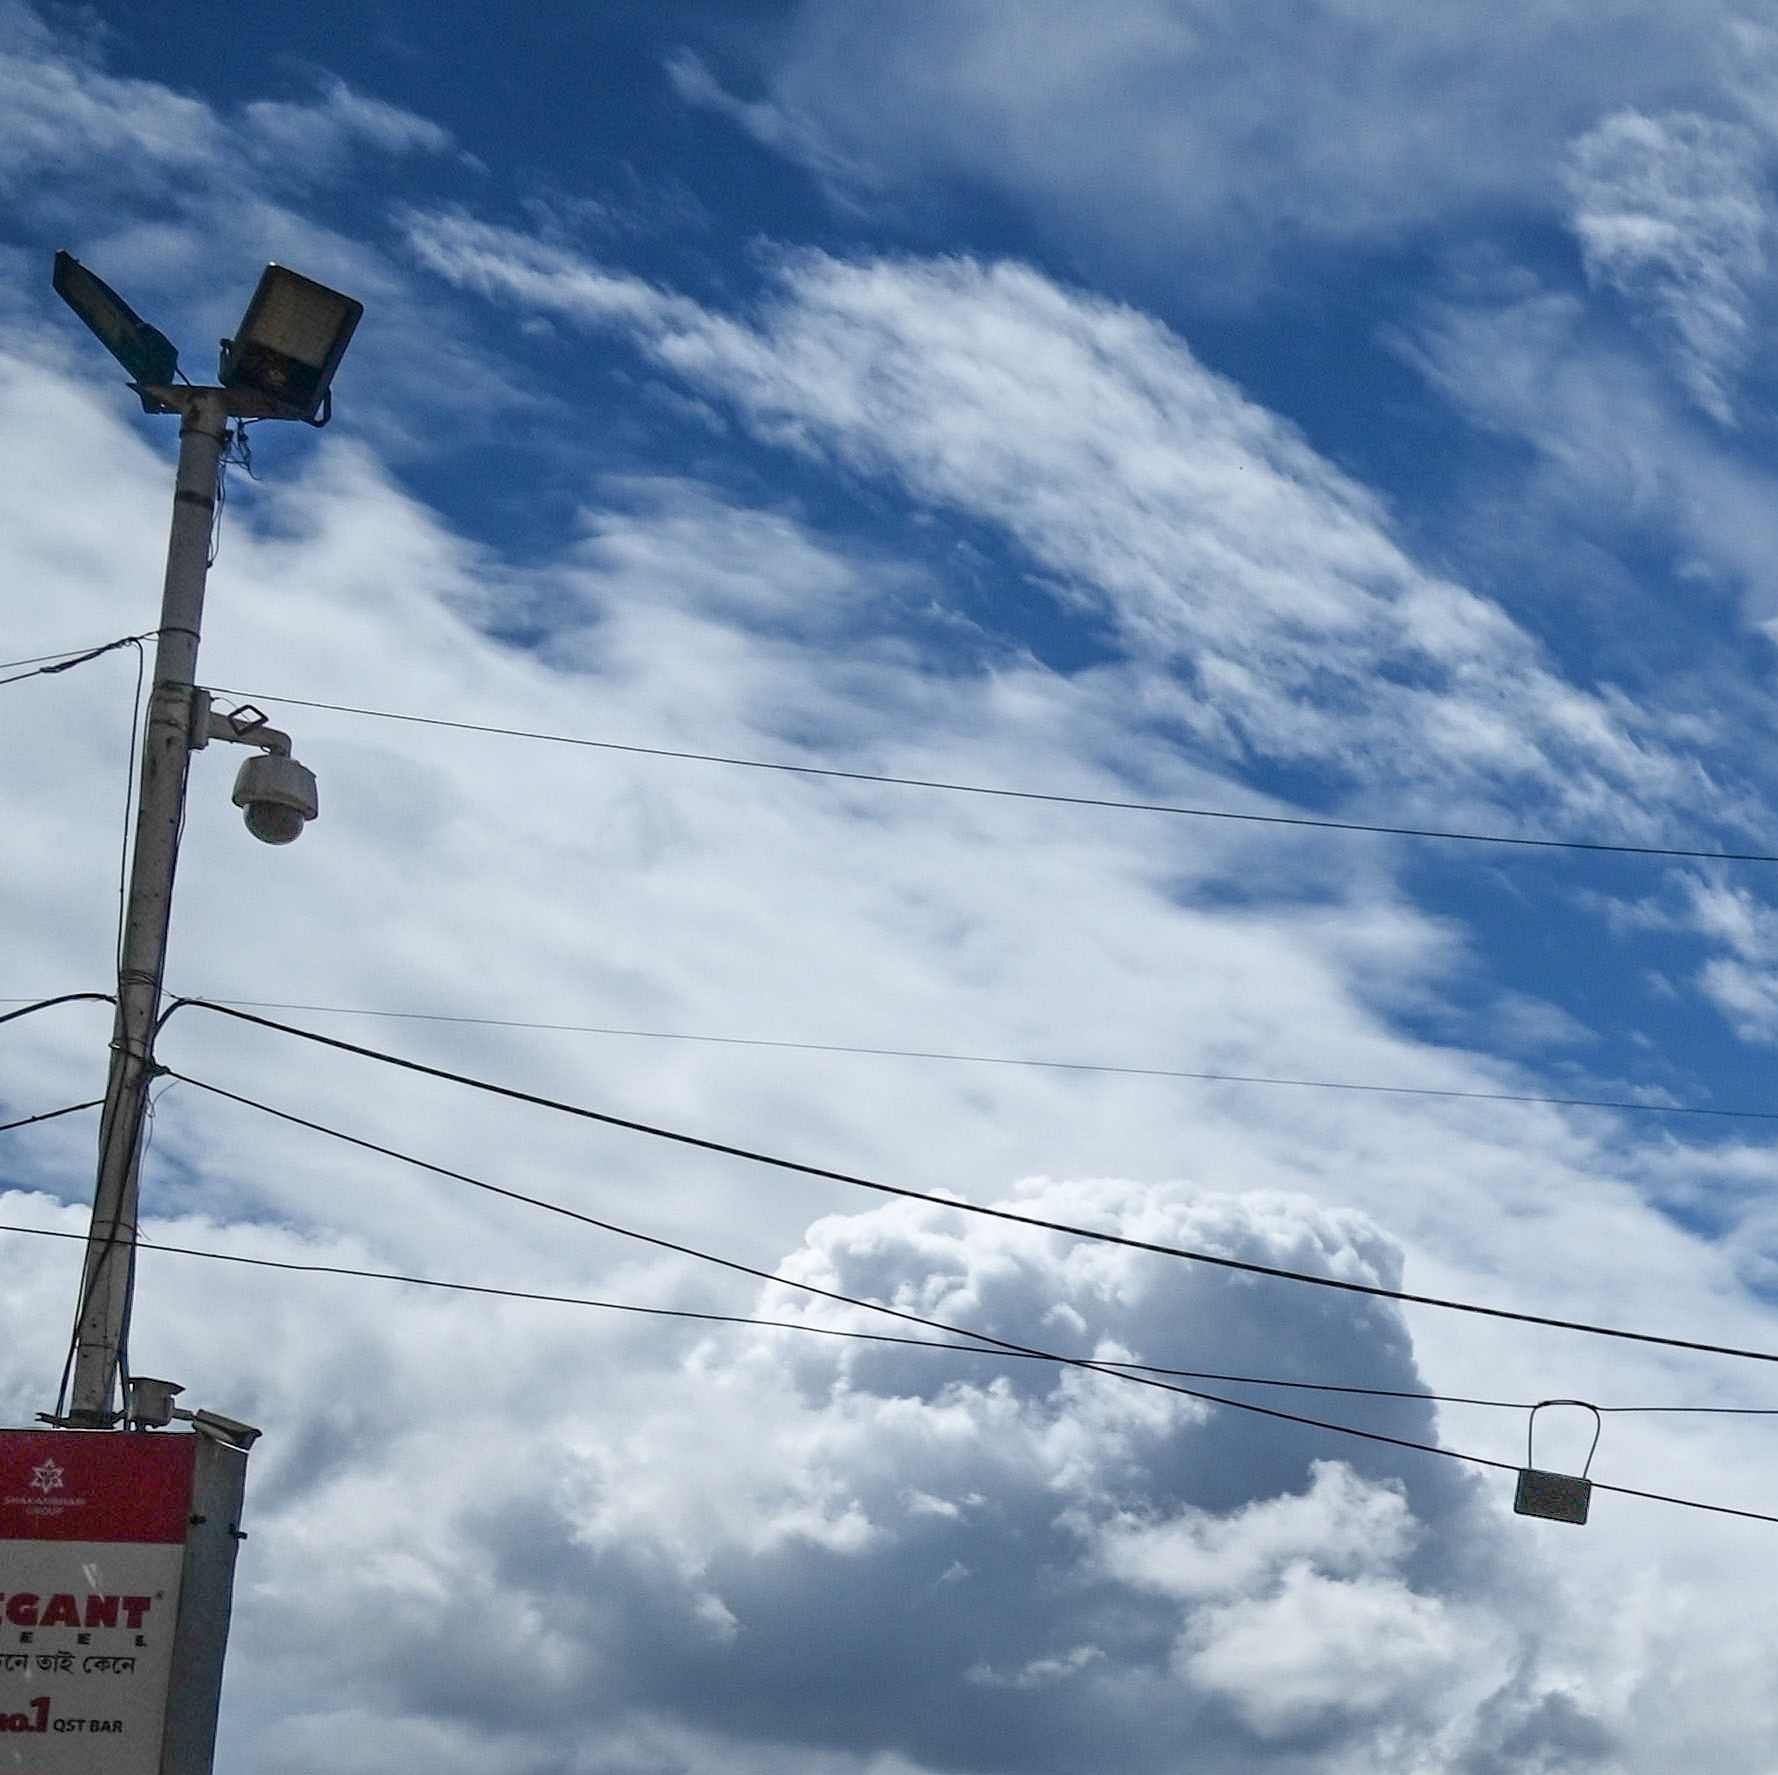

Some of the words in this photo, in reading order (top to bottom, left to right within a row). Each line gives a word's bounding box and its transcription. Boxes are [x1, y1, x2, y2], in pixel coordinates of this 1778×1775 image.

[0, 1592, 152, 1629] GANT
[36, 1651, 75, 1674] তাই
[83, 1656, 135, 1674] কেনে
[53, 1718, 86, 1733] QST
[90, 1720, 122, 1733] BAR
